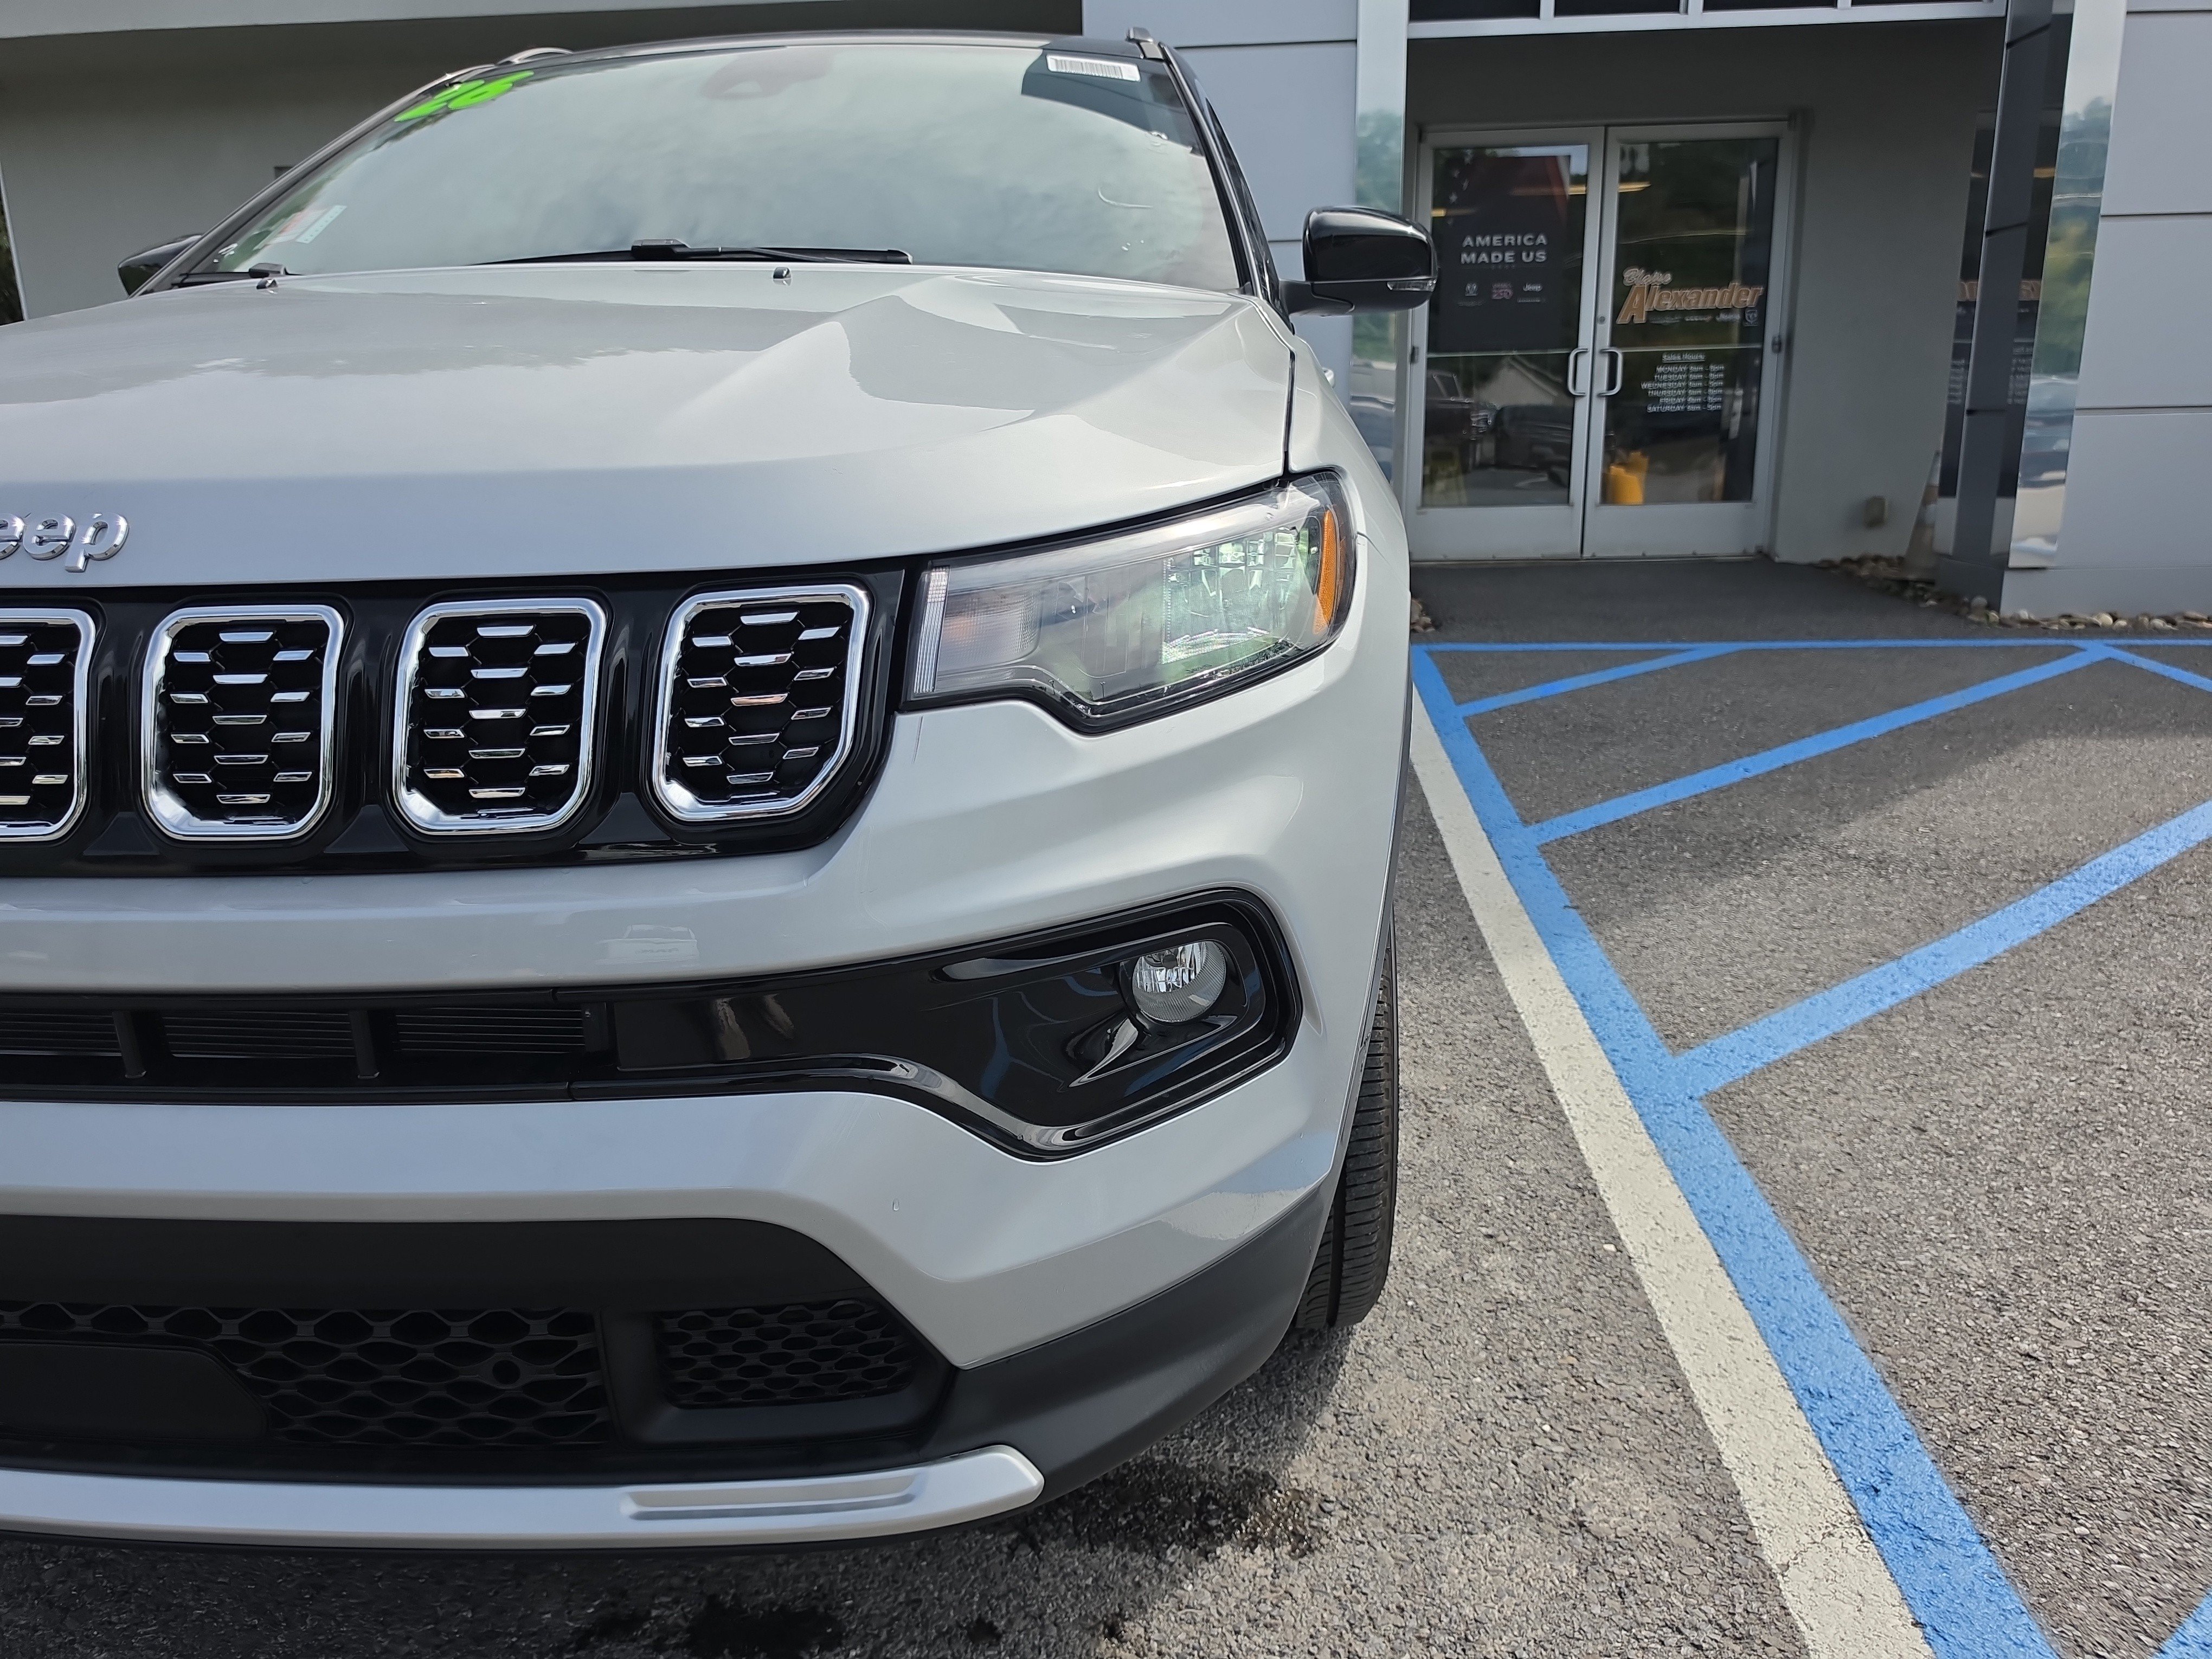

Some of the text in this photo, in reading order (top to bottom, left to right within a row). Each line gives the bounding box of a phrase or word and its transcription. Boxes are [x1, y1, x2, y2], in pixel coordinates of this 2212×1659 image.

[1462, 233, 1547, 248] AMERICA
[1461, 250, 1547, 265] MADE US
[1616, 282, 1764, 325] Alexander
[1655, 373, 1686, 381] TUESDAY
[1641, 381, 1686, 389] WEDNESDAY
[1648, 389, 1686, 397] THURSDAY
[1647, 404, 1686, 413] SATURDAY
